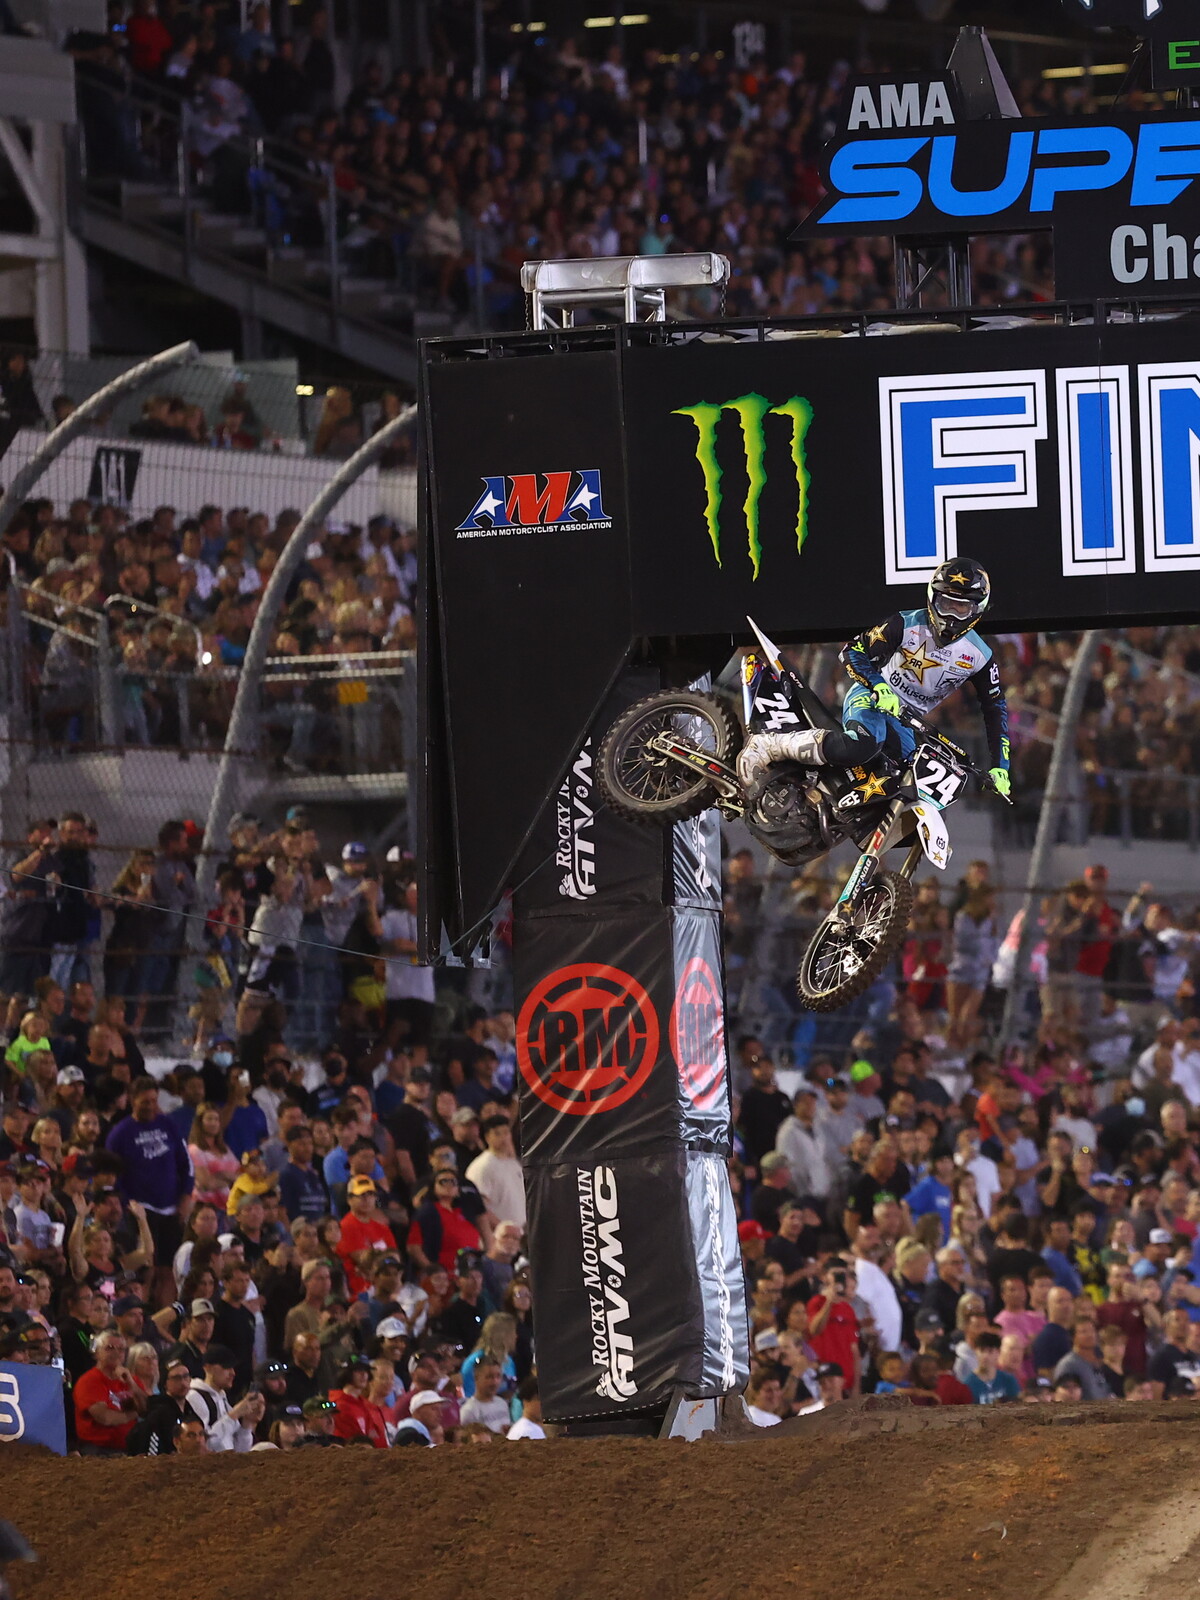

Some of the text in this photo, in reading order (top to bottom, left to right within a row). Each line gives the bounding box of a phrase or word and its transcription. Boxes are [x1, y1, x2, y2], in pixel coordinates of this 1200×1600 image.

[846, 81, 956, 131] AMA
[454, 469, 613, 531] AMA
[456, 521, 612, 539] AMERICAN MOTORCYCLIST ASSOCIATION
[754, 692, 801, 730] 24
[916, 760, 962, 807] 24
[556, 801, 572, 870] ROCKY
[542, 1005, 632, 1074] RM
[576, 1167, 609, 1368] ROCKY MOUNTAIN
